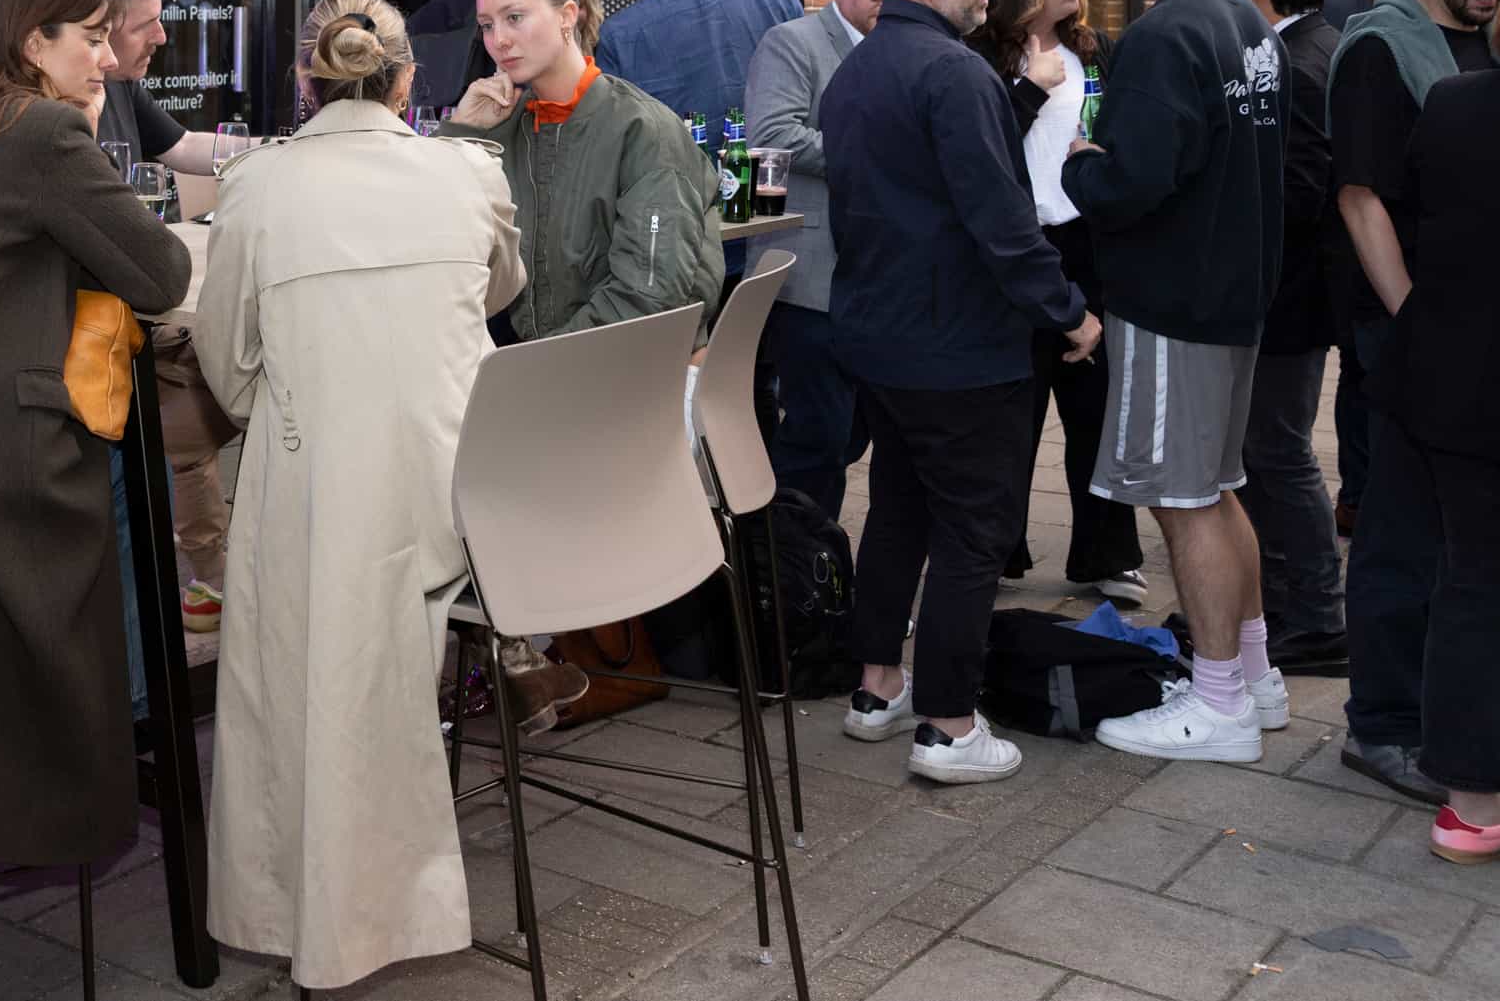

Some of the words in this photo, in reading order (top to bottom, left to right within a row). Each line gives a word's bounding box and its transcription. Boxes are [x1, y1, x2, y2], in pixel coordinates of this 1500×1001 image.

[161, 5, 186, 20] nilin
[190, 5, 234, 20] Panels?
[165, 70, 228, 90] competitor
[159, 94, 203, 111] rniture?
